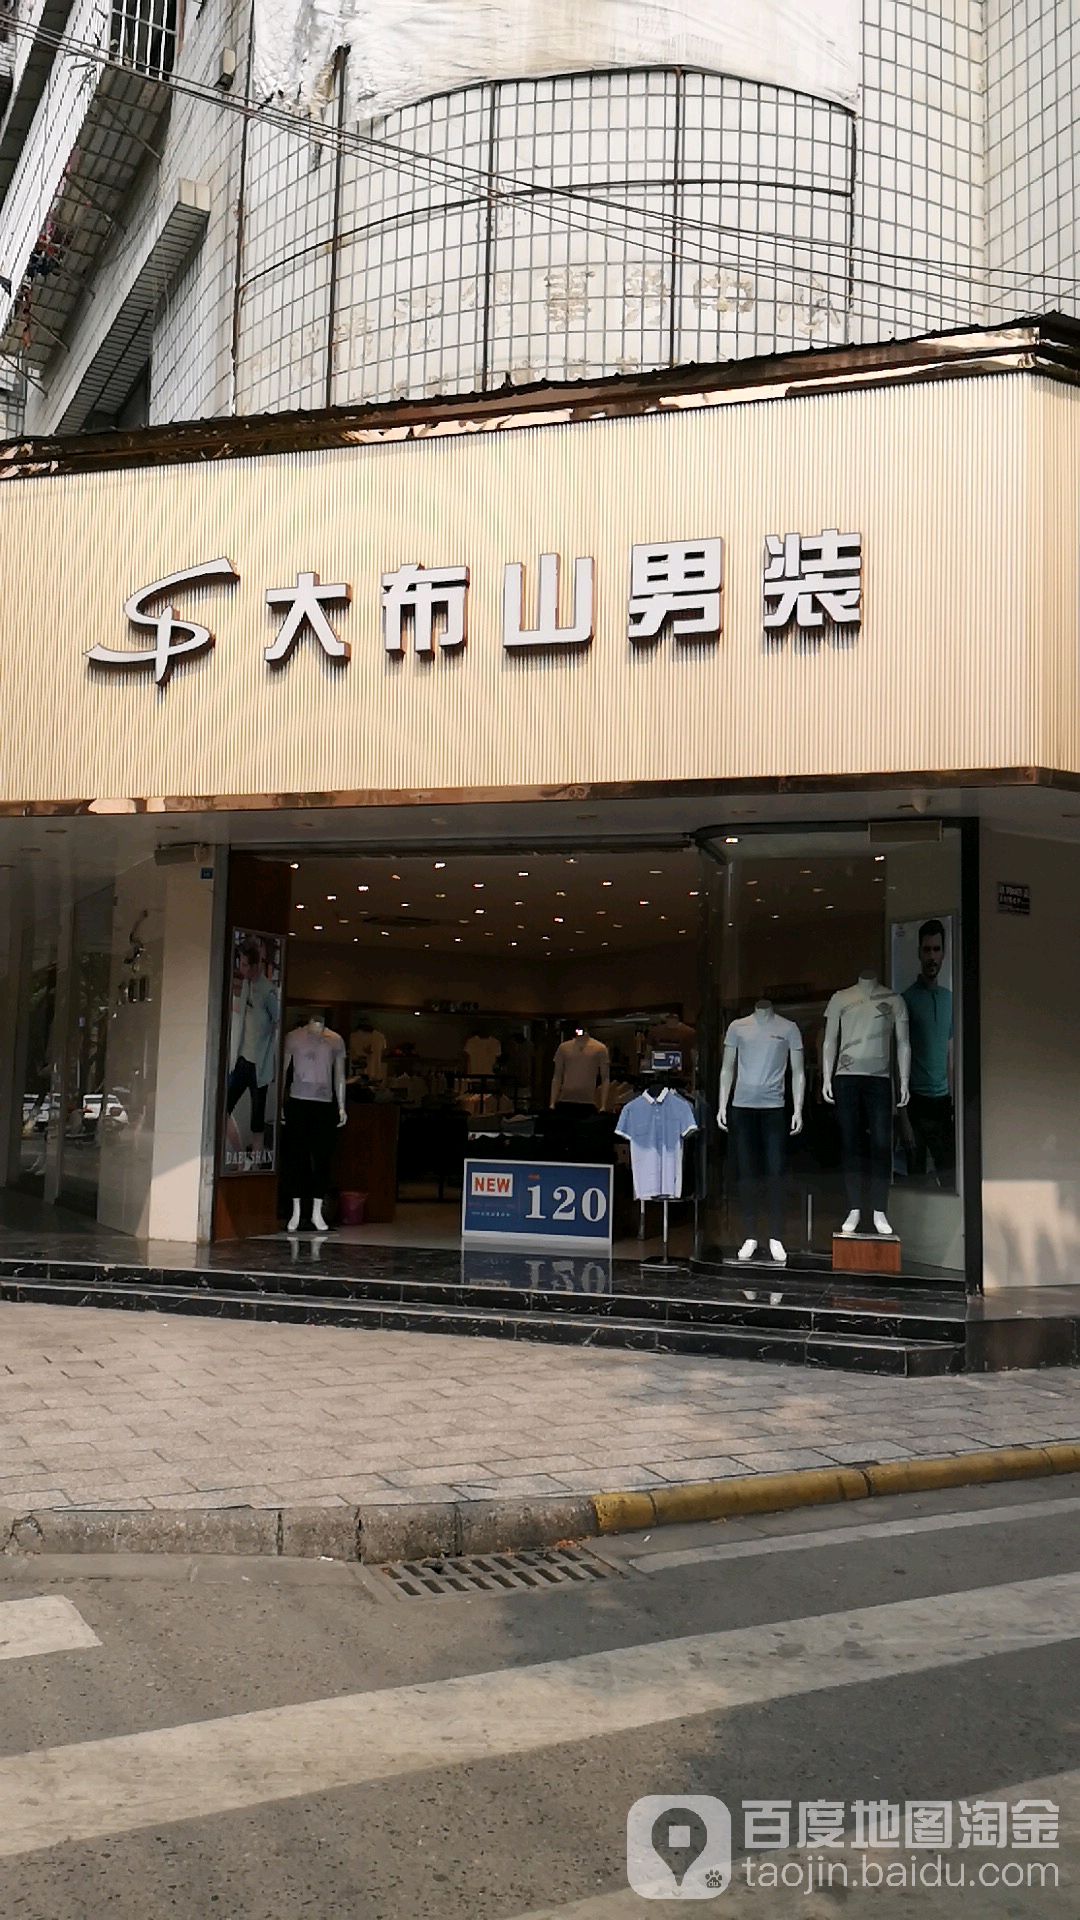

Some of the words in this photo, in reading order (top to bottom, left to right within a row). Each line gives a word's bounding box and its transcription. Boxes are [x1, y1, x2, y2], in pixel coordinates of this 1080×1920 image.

[265, 529, 862, 667] 大布山男装
[474, 1176, 510, 1193] NEW
[525, 1185, 607, 1222] 120
